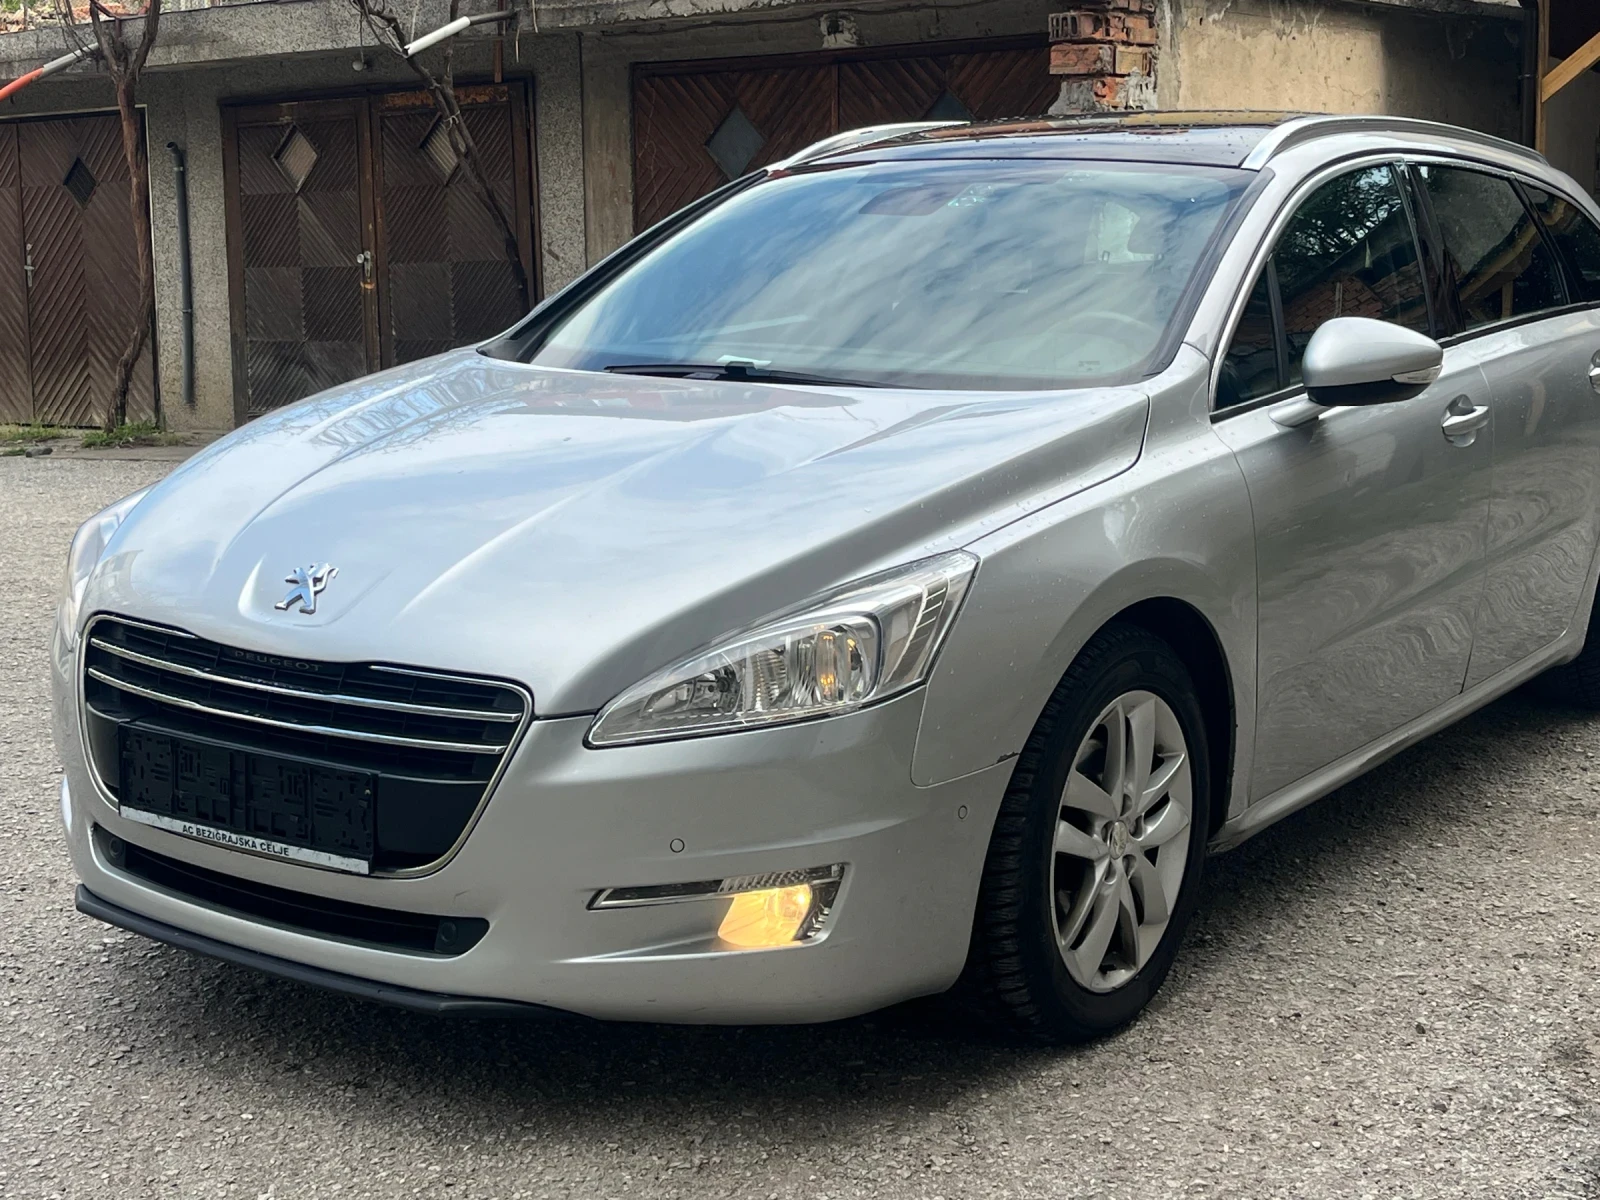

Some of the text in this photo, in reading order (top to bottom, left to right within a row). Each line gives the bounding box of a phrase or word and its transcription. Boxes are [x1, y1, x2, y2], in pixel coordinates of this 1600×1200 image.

[235, 650, 322, 672] PEUGEOT
[182, 824, 194, 835] AC
[260, 842, 290, 856] CELJE
